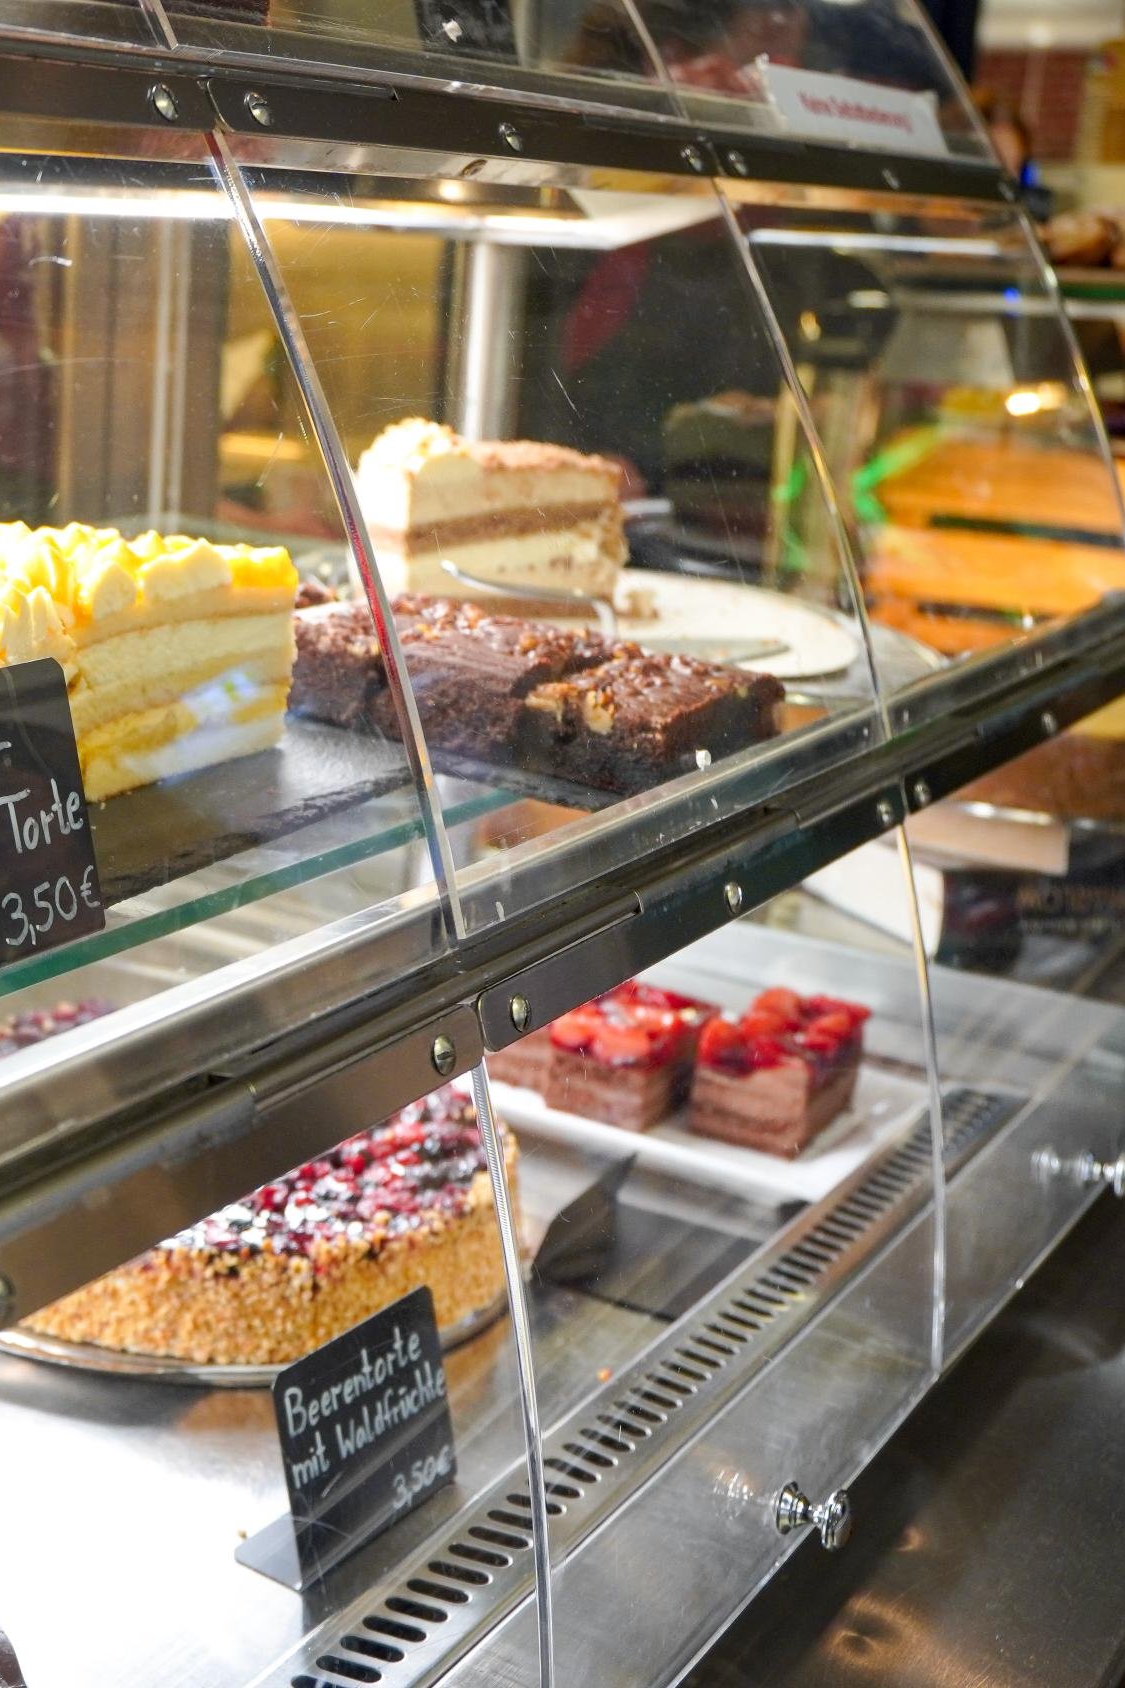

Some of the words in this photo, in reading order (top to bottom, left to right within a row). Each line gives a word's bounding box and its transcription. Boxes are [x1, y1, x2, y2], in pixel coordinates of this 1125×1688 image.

[1, 864, 101, 946] 3,50€
[283, 1326, 423, 1438] Beerentorte
[291, 1431, 331, 1490] mit
[335, 1360, 446, 1460] Waldfrüchte
[392, 1444, 452, 1510] 3,50€
